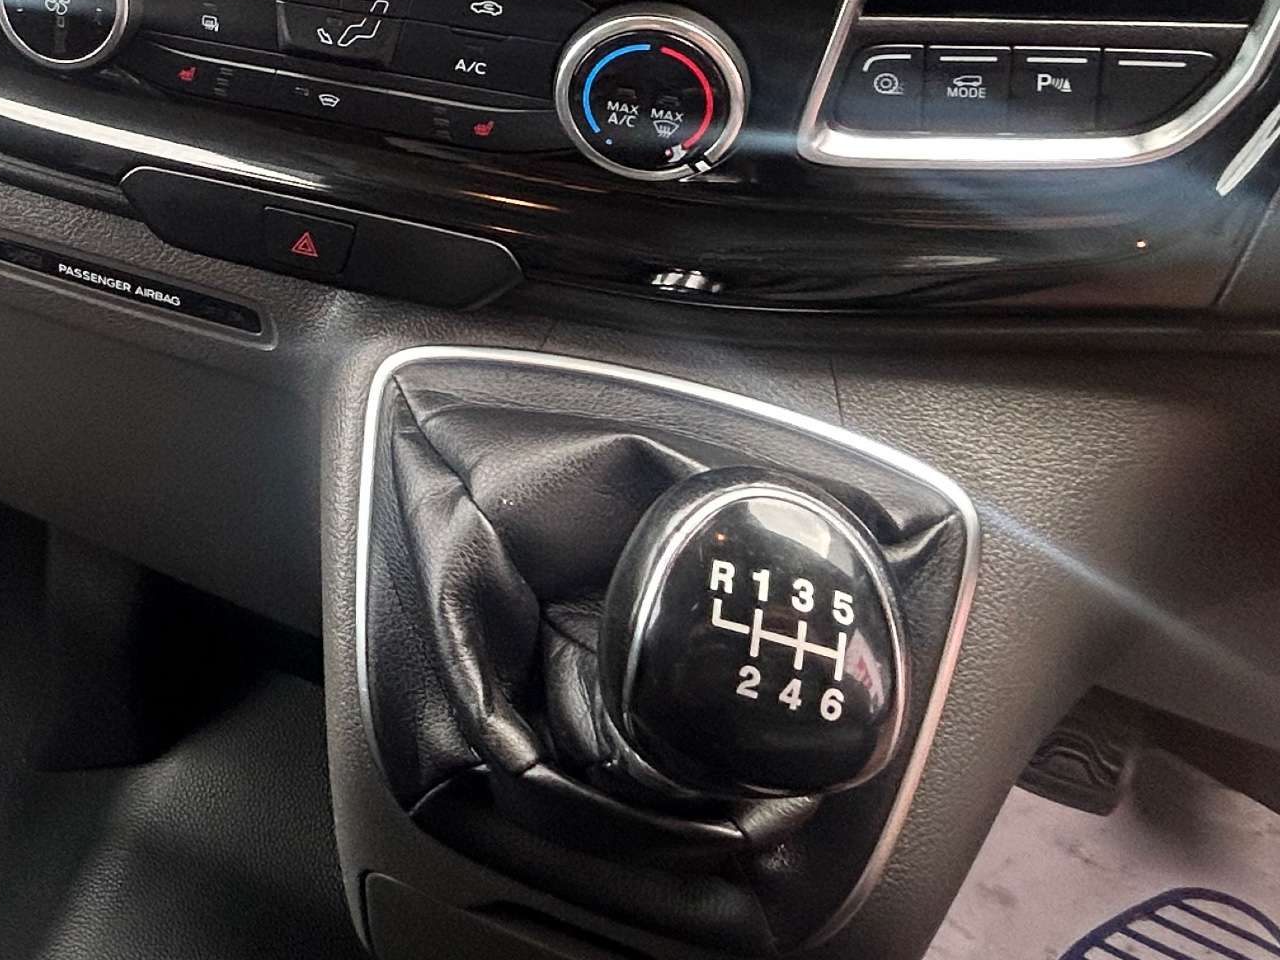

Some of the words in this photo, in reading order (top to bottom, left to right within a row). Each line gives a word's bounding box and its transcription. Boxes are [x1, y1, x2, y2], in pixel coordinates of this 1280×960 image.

[455, 58, 487, 75] A/C
[946, 86, 988, 100] MODE
[607, 100, 639, 115] MAX
[650, 107, 685, 122] MAX
[608, 111, 637, 128] A/C
[58, 263, 131, 293] PASSENGER
[134, 286, 181, 307] AIRBAG
[710, 559, 735, 594] R
[752, 569, 770, 601] 1
[792, 578, 815, 613] 3
[832, 590, 854, 625] 5
[736, 665, 761, 699] 2
[778, 678, 802, 711] 4
[820, 688, 845, 721] 6
